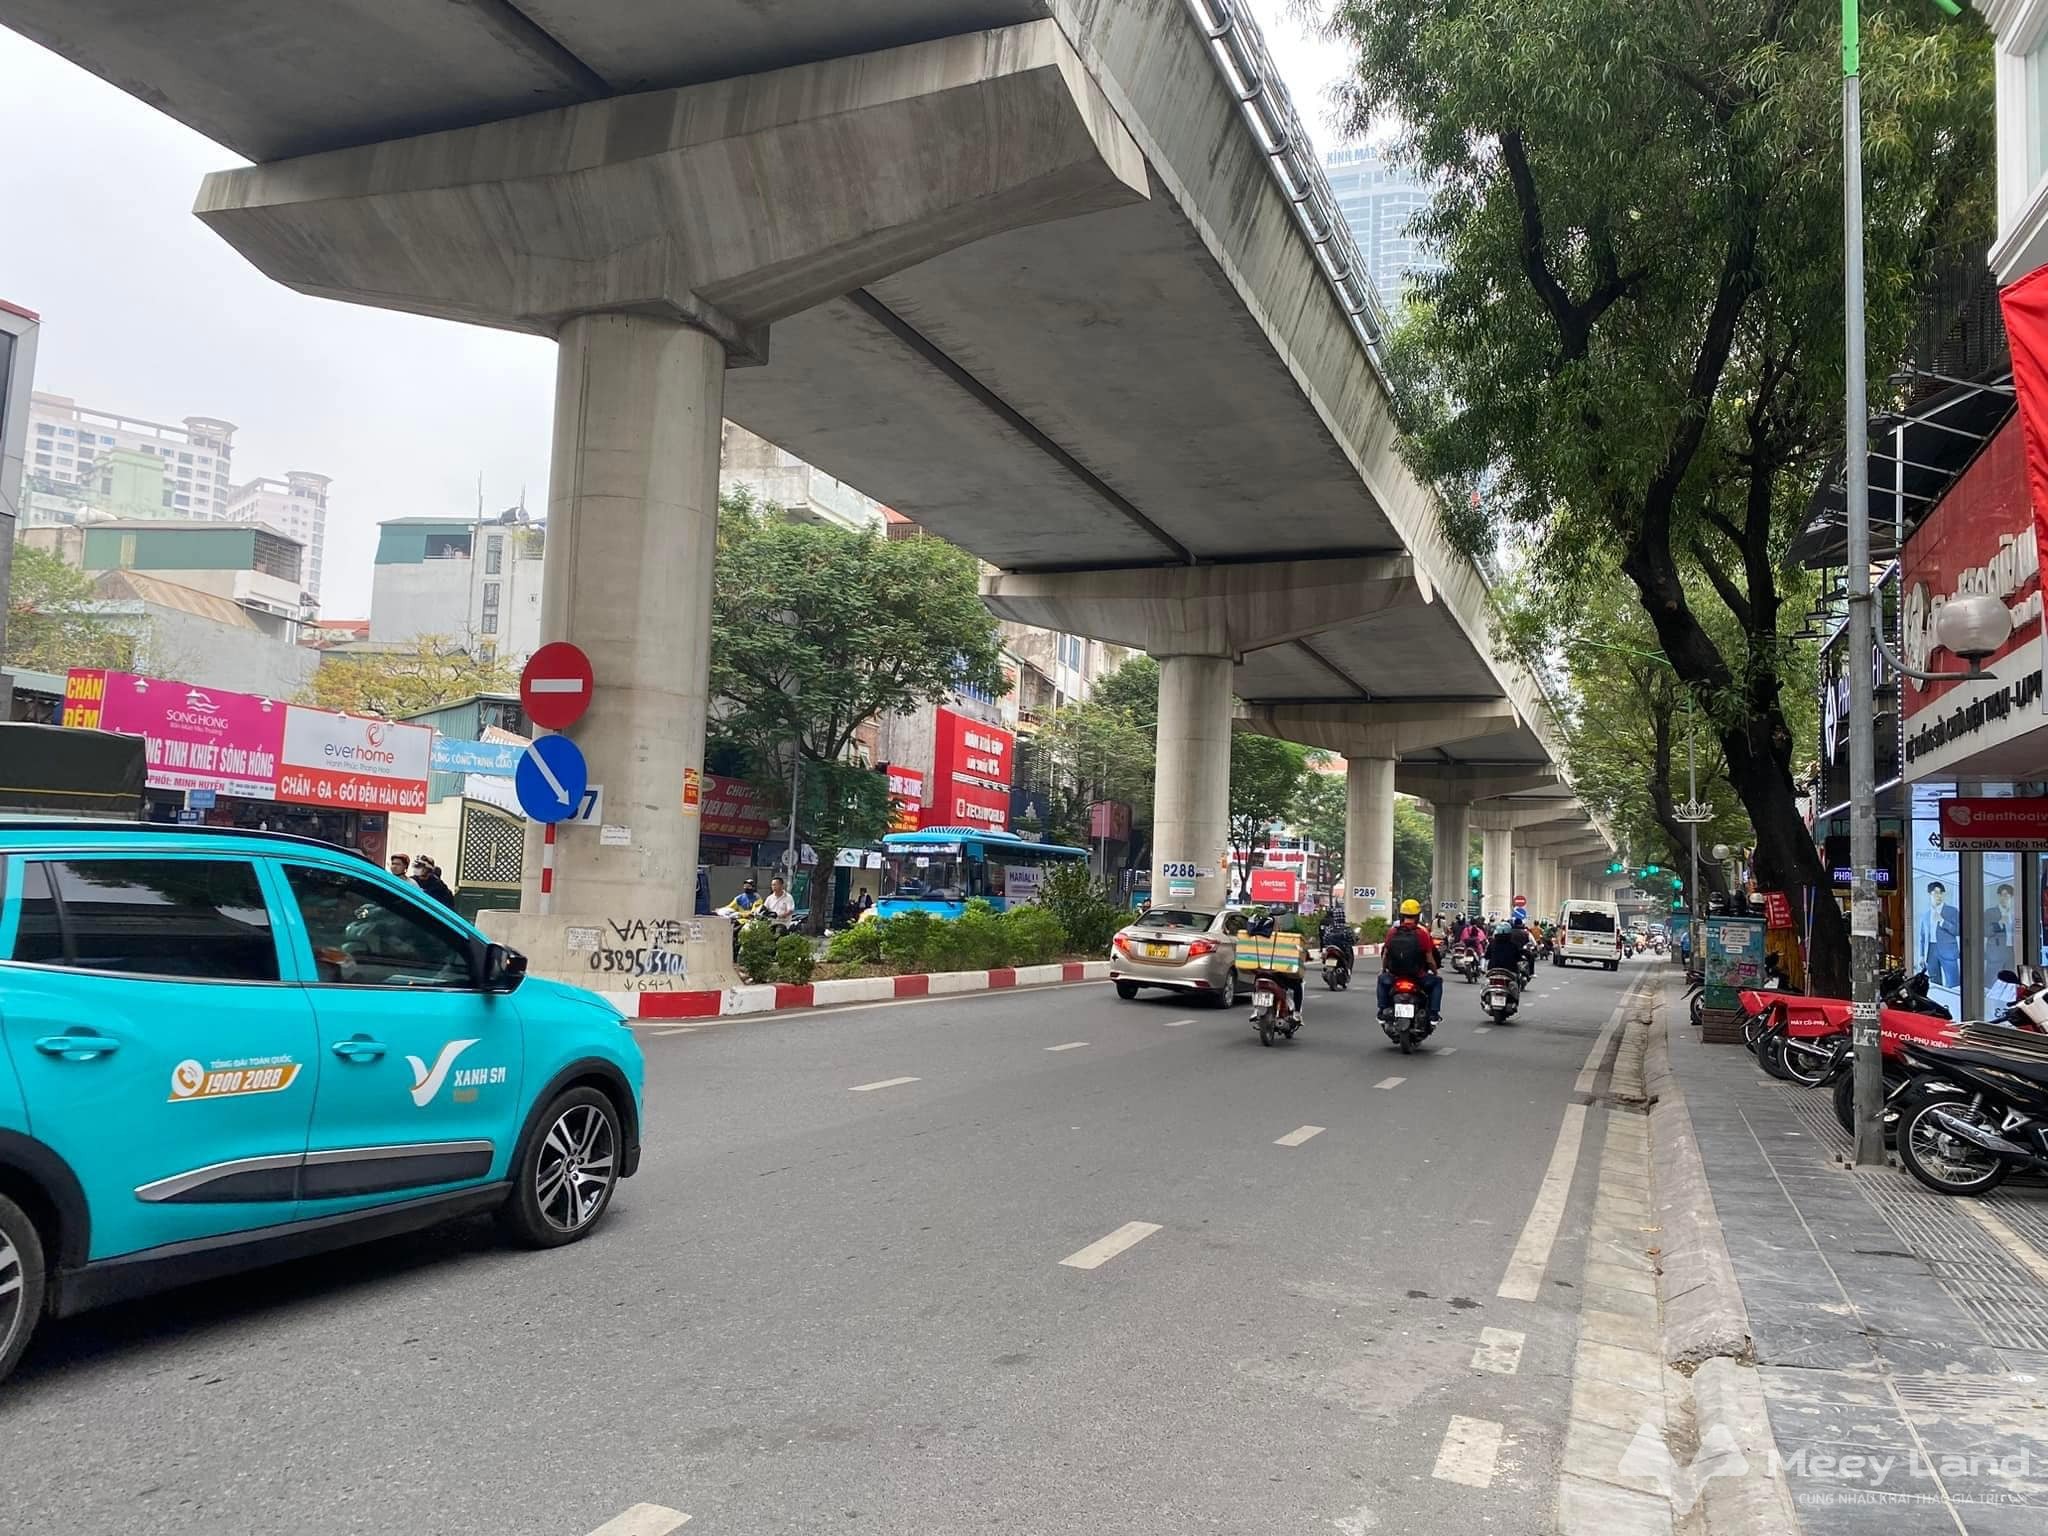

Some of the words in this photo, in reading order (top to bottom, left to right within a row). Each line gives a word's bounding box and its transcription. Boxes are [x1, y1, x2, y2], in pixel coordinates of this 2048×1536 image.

[67, 674, 103, 700] CHĂN
[164, 738, 190, 768] TINH
[190, 737, 219, 772] KHIẾT
[219, 742, 246, 775] SÔNG
[324, 743, 394, 764] everhome
[281, 774, 311, 796] CHĂN
[317, 780, 333, 800] GA
[339, 777, 358, 803] GỐI
[358, 780, 378, 808] ĐỆM
[379, 783, 399, 807] HÀN
[399, 783, 426, 808] QUỐC
[1163, 863, 1195, 878] P288
[1354, 887, 1376, 898] P289
[204, 1071, 243, 1093] 1900
[242, 1068, 284, 1090] 2088
[454, 1068, 489, 1087] XANH
